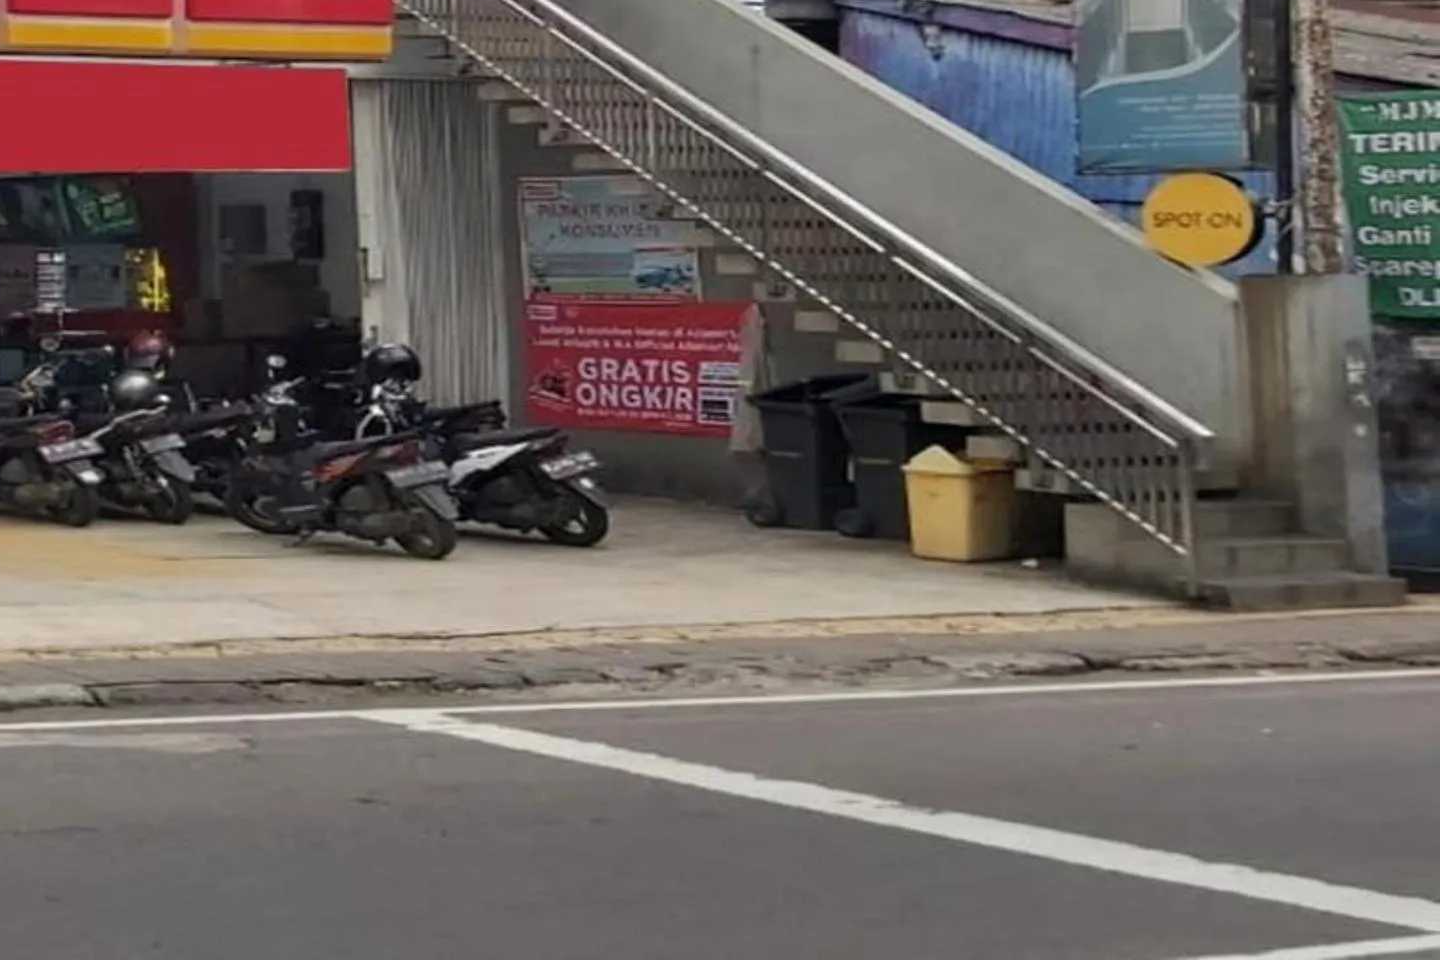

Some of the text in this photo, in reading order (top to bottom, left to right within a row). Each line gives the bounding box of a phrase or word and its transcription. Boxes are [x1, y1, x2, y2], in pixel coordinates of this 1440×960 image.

[1152, 211, 1243, 229] SPOT ON
[1358, 225, 1431, 246] Ganti
[577, 356, 691, 384] GRATIS
[575, 383, 694, 411] ONGKIR
